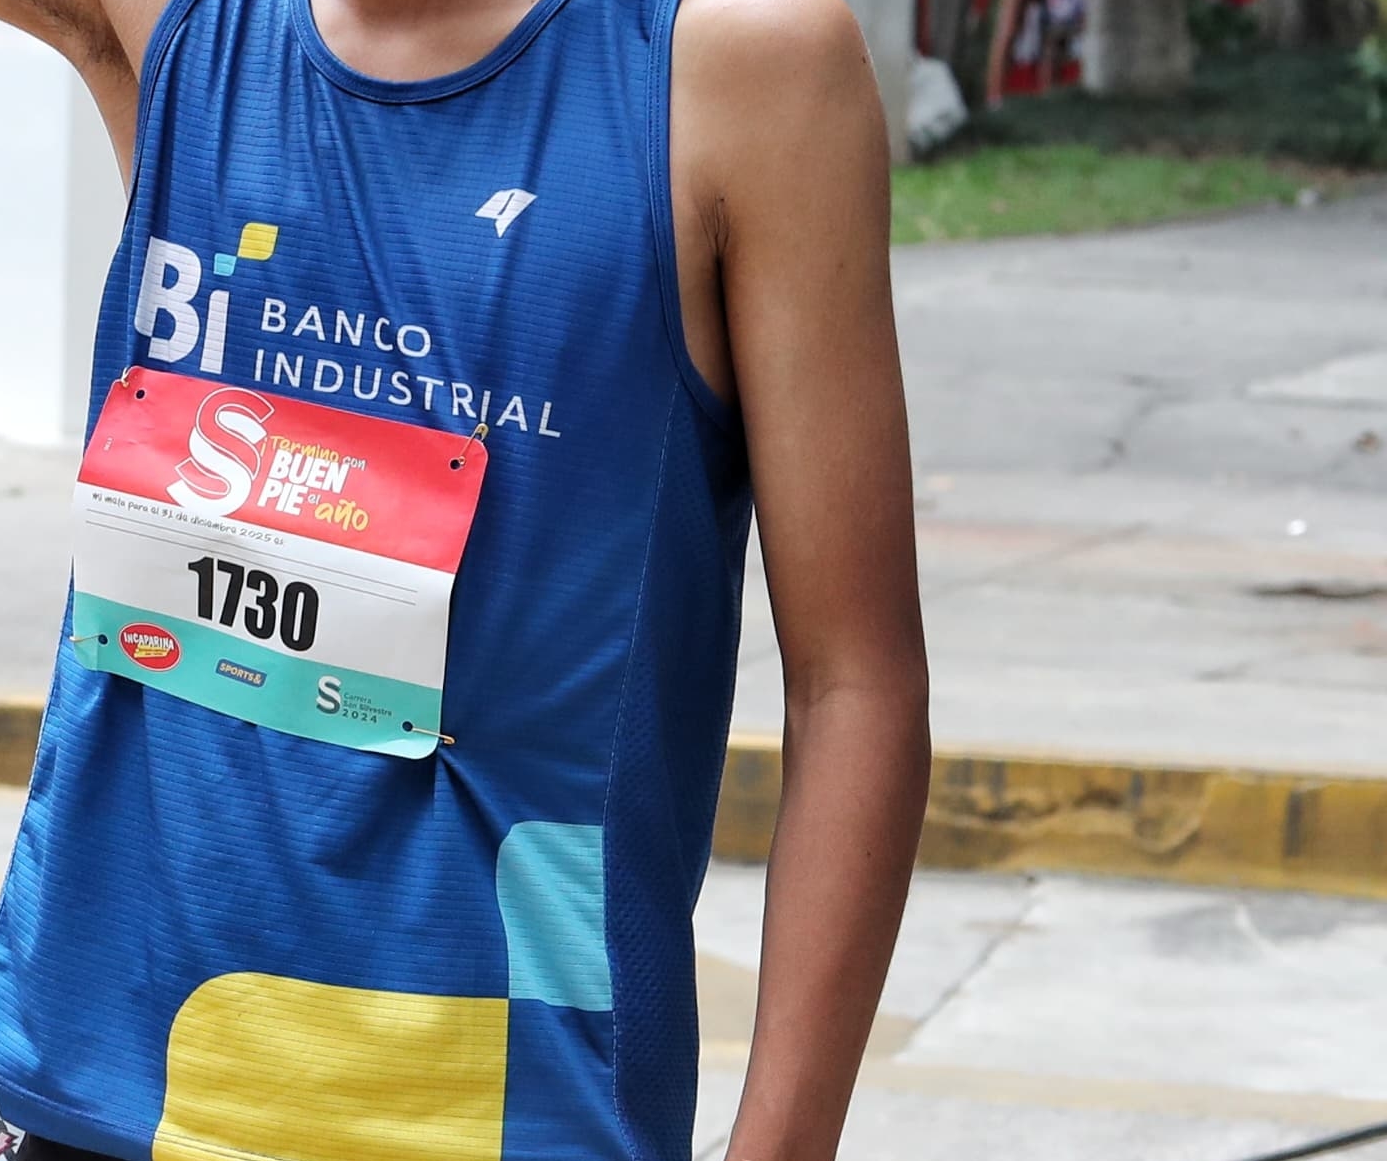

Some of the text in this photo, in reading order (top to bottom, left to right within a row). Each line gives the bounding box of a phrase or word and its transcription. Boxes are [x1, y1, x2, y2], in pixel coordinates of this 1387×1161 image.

[134, 236, 238, 374] Bi
[261, 297, 432, 358] BANCO
[254, 349, 562, 438] INDUSTRIAL
[268, 449, 350, 494] BUEN
[343, 455, 366, 471] con
[128, 501, 148, 511] para
[162, 509, 173, 518] 31
[176, 512, 188, 523] de
[191, 517, 237, 533] diciembre
[240, 528, 273, 542] 2025
[257, 478, 369, 531] PIE el año
[188, 556, 319, 651] 1730
[123, 631, 175, 650] INCAPARINA
[219, 662, 263, 685] SPORTS&
[342, 709, 377, 723] 2024
[343, 692, 372, 704] Carrera
[343, 700, 357, 709] San
